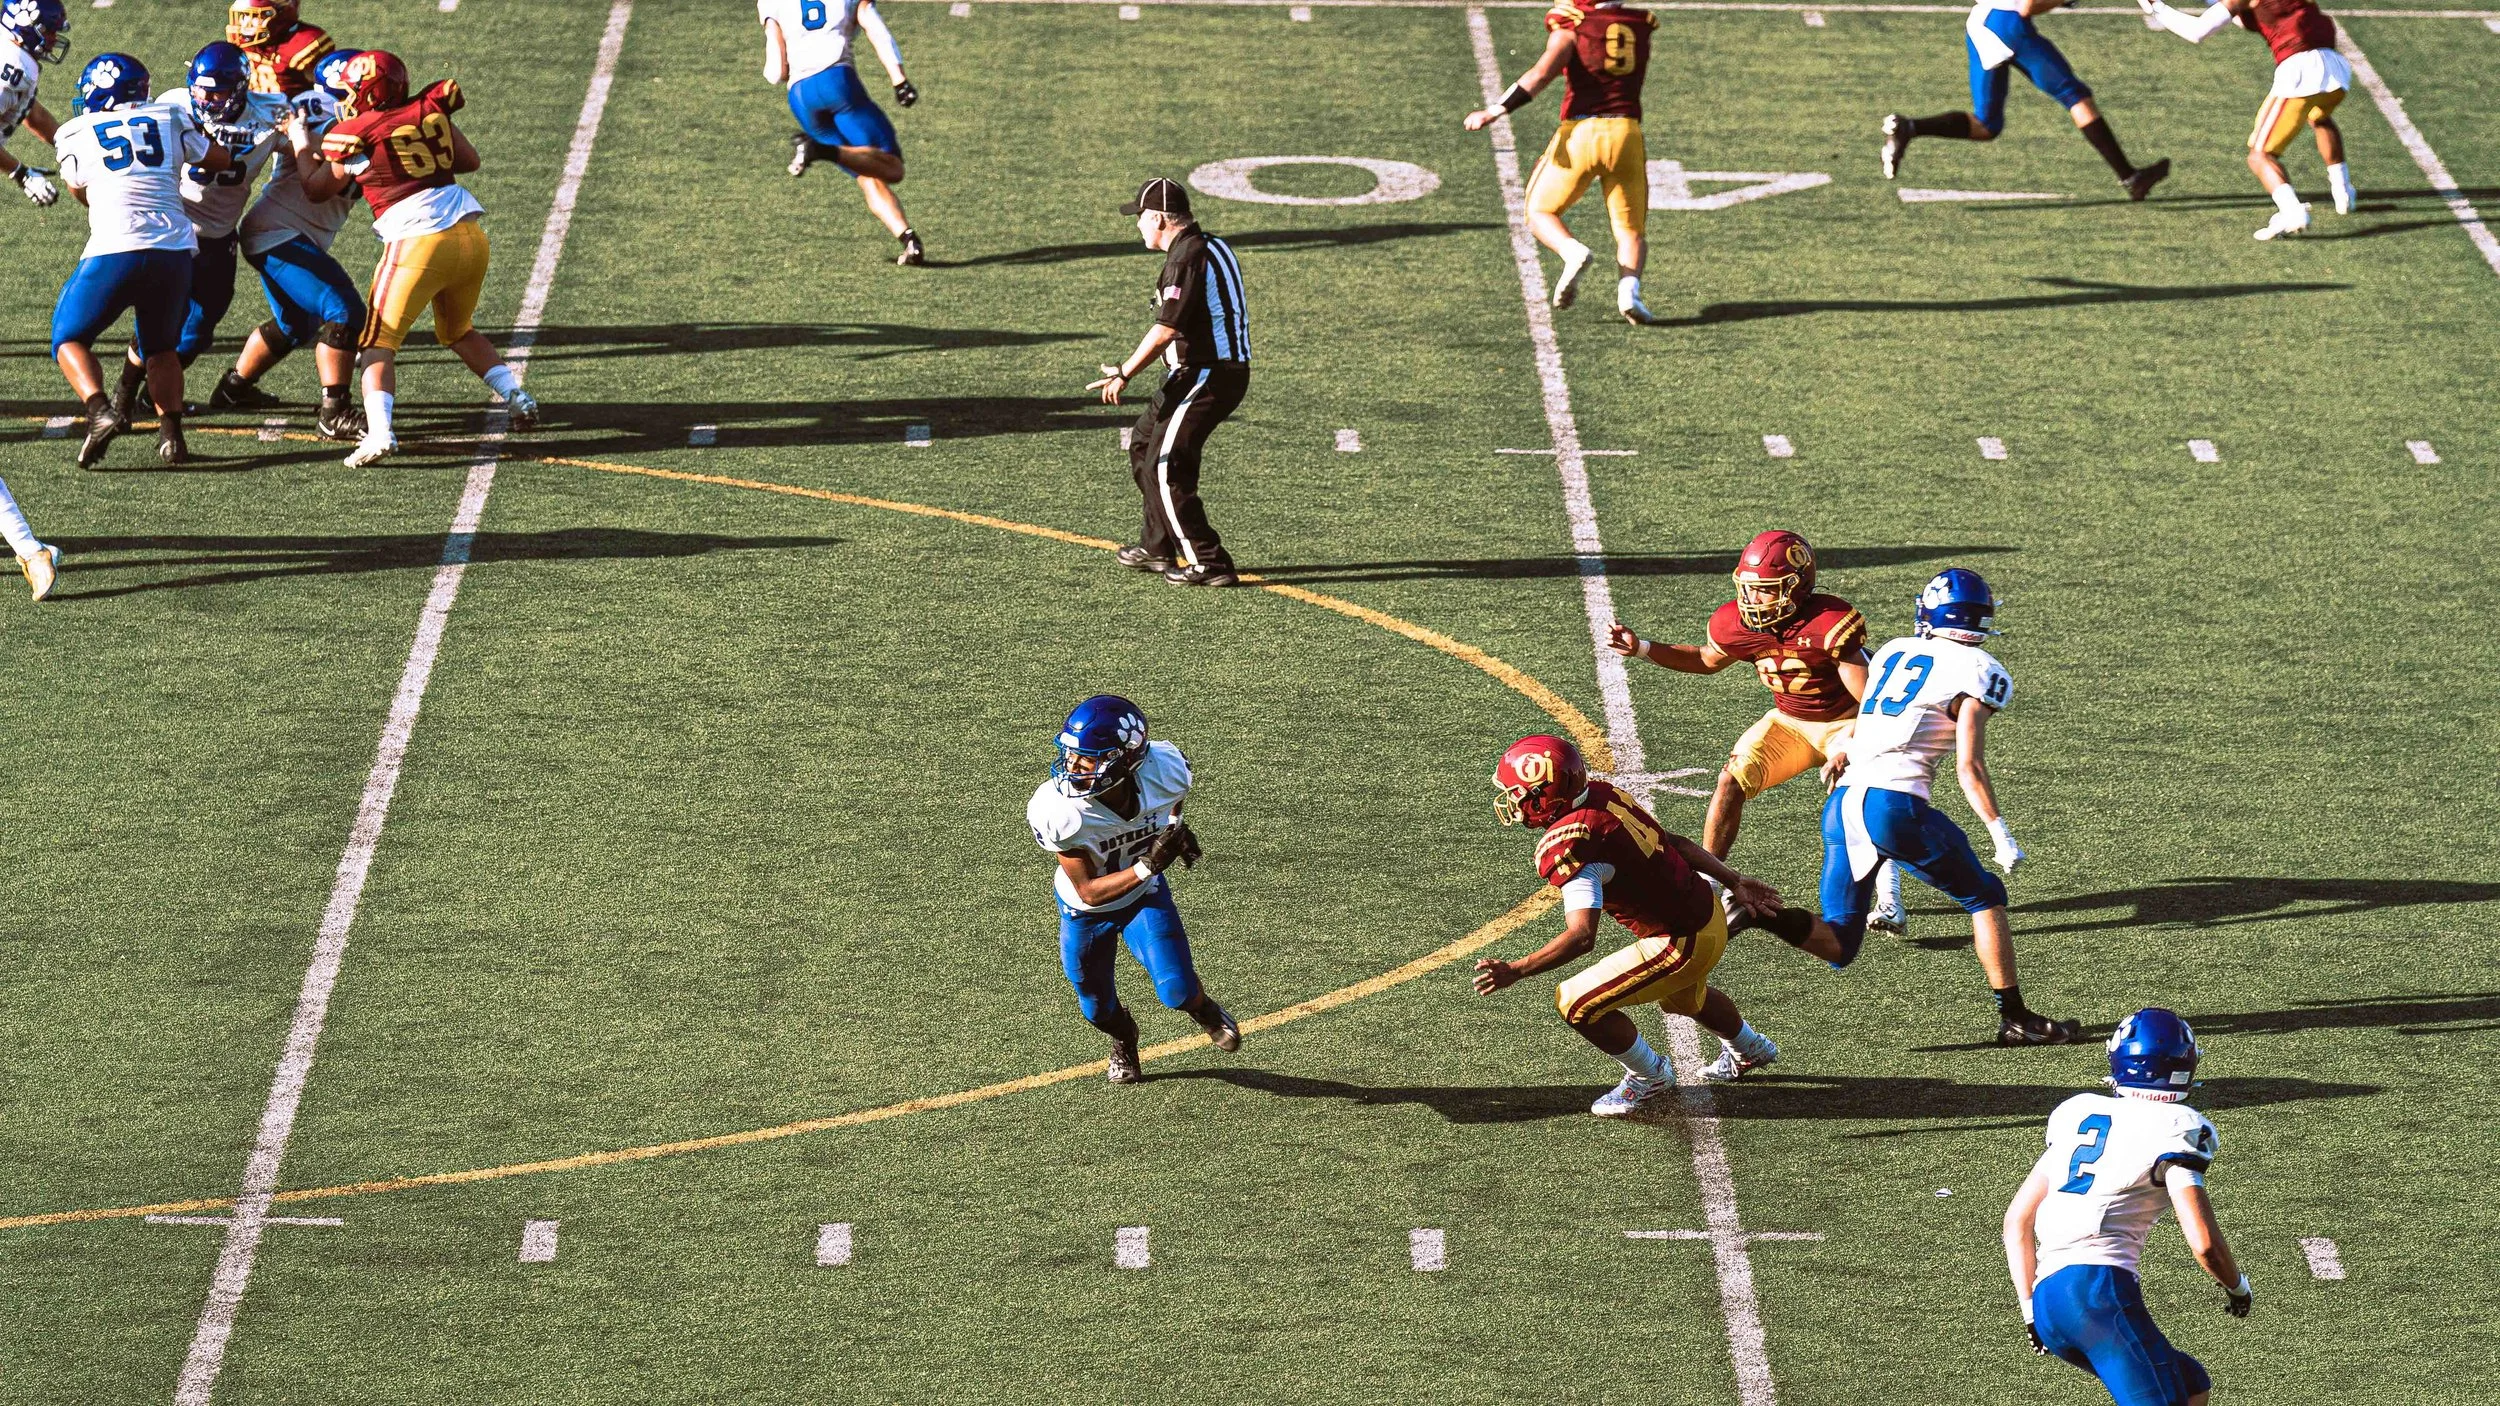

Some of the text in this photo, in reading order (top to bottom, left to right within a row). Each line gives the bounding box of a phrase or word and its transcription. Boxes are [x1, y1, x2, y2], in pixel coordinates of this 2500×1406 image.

[1, 63, 25, 87] 50
[1603, 23, 1637, 76] 9
[92, 116, 165, 172] 53
[188, 144, 257, 187] 5
[390, 112, 455, 178] 63
[1861, 651, 1935, 718] 13
[1985, 672, 2009, 703] 13
[1553, 847, 1581, 877] 41
[2057, 1113, 2113, 1196] 2
